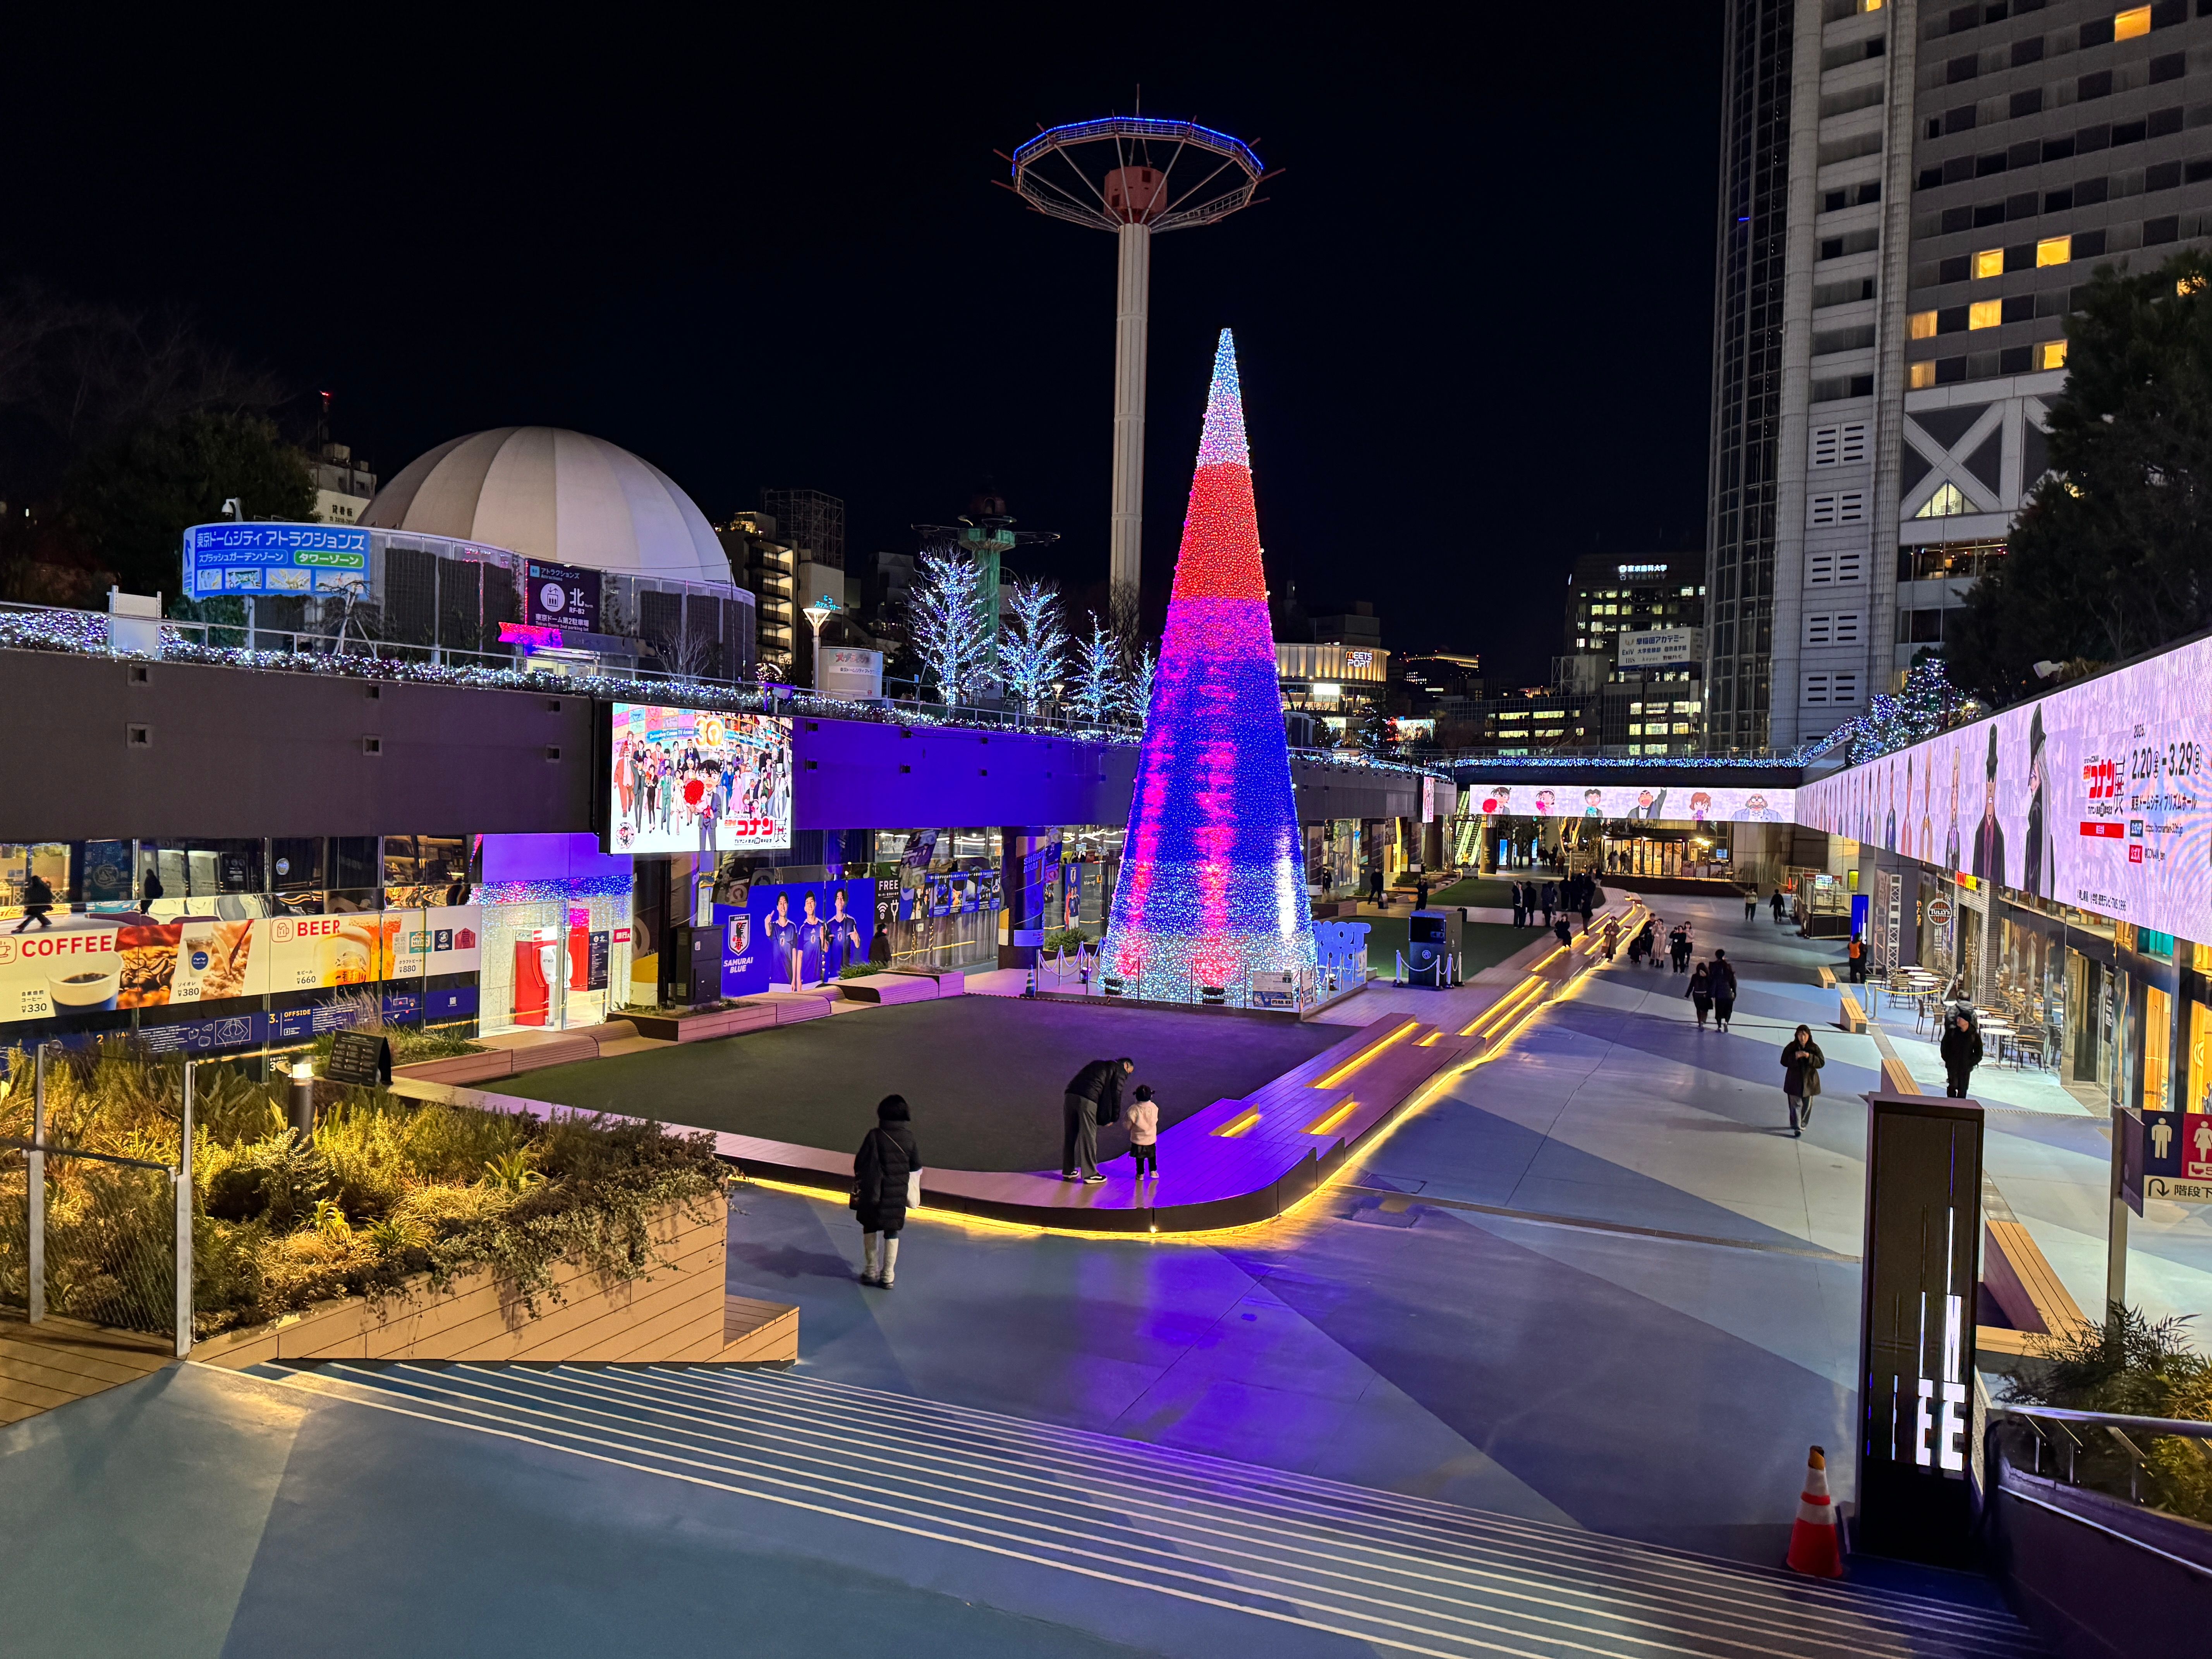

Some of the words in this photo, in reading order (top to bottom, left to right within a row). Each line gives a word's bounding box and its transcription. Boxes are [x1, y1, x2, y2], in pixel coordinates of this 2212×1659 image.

[197, 531, 261, 548] 東京ドームシティ
[266, 531, 364, 550] アトラクションズ
[199, 551, 284, 563] スプラッシュガーデンゾーン
[299, 553, 359, 565] タワーゾーン
[541, 568, 580, 579] アトラクションズ
[570, 588, 584, 607] 北
[1636, 635, 1685, 645] 早稲田アカデミー
[1345, 651, 1372, 660] MEETS
[1347, 659, 1370, 668] PORT
[696, 719, 723, 746] 30
[1023, 861, 1038, 873] AKAI
[879, 879, 899, 891] FREE
[297, 920, 340, 936] BEER
[22, 935, 112, 957] COFFEE
[723, 957, 754, 967] SAMURAI
[730, 965, 746, 974] BLUE
[297, 975, 316, 984] ¥660
[177, 988, 199, 997] ¥380
[21, 1003, 47, 1013] ¥330
[269, 1013, 278, 1024] 3.
[284, 1009, 311, 1018] OFFSIDE
[2174, 1184, 2212, 1199] 階段下
